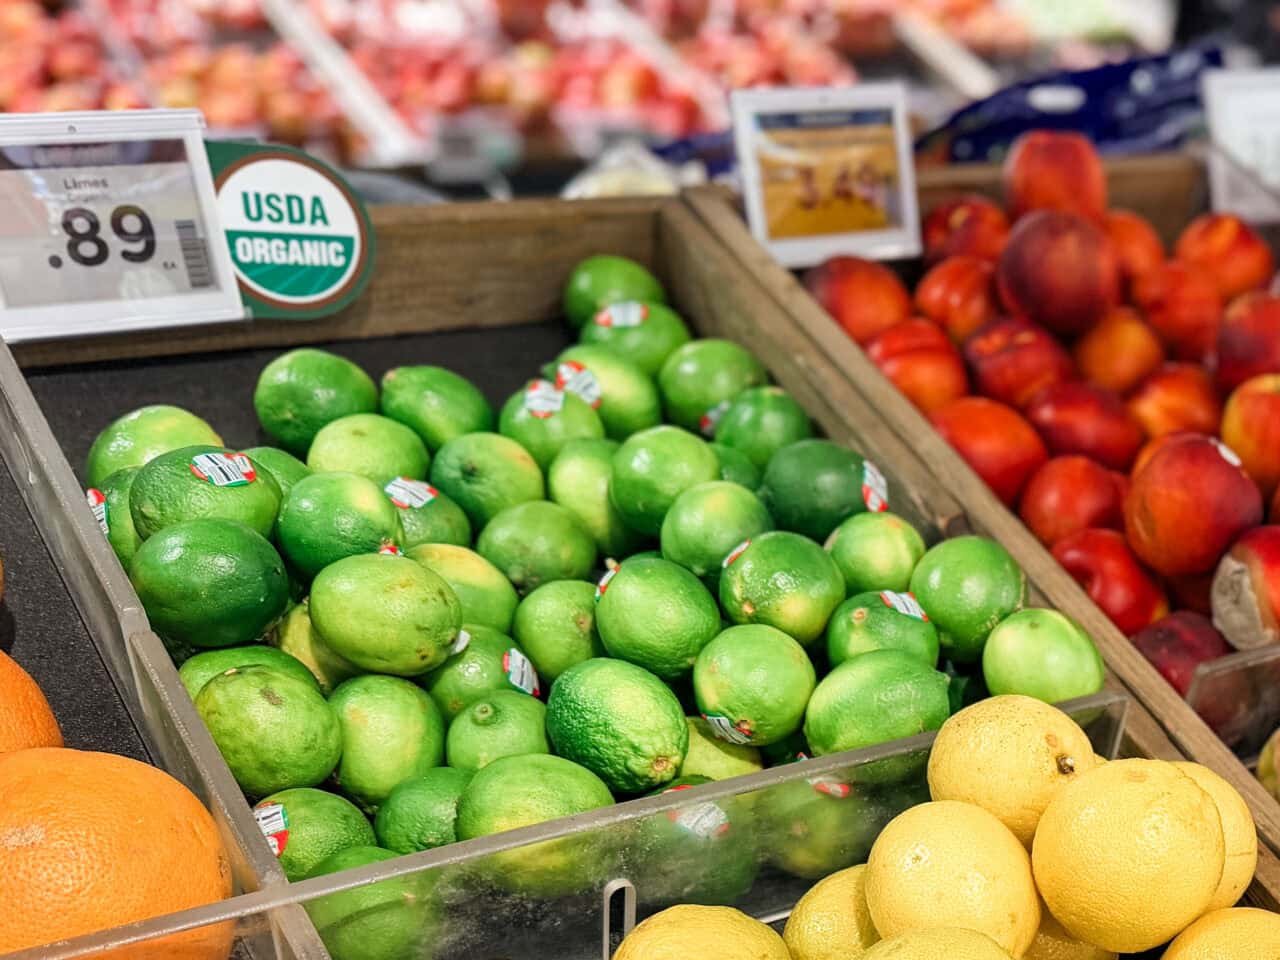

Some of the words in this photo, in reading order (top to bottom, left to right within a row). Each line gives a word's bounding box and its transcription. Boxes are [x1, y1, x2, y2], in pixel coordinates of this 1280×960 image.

[63, 179, 109, 190] Limes
[242, 190, 330, 226] USDA
[48, 205, 156, 269] .89
[235, 235, 346, 268] ORGANIC
